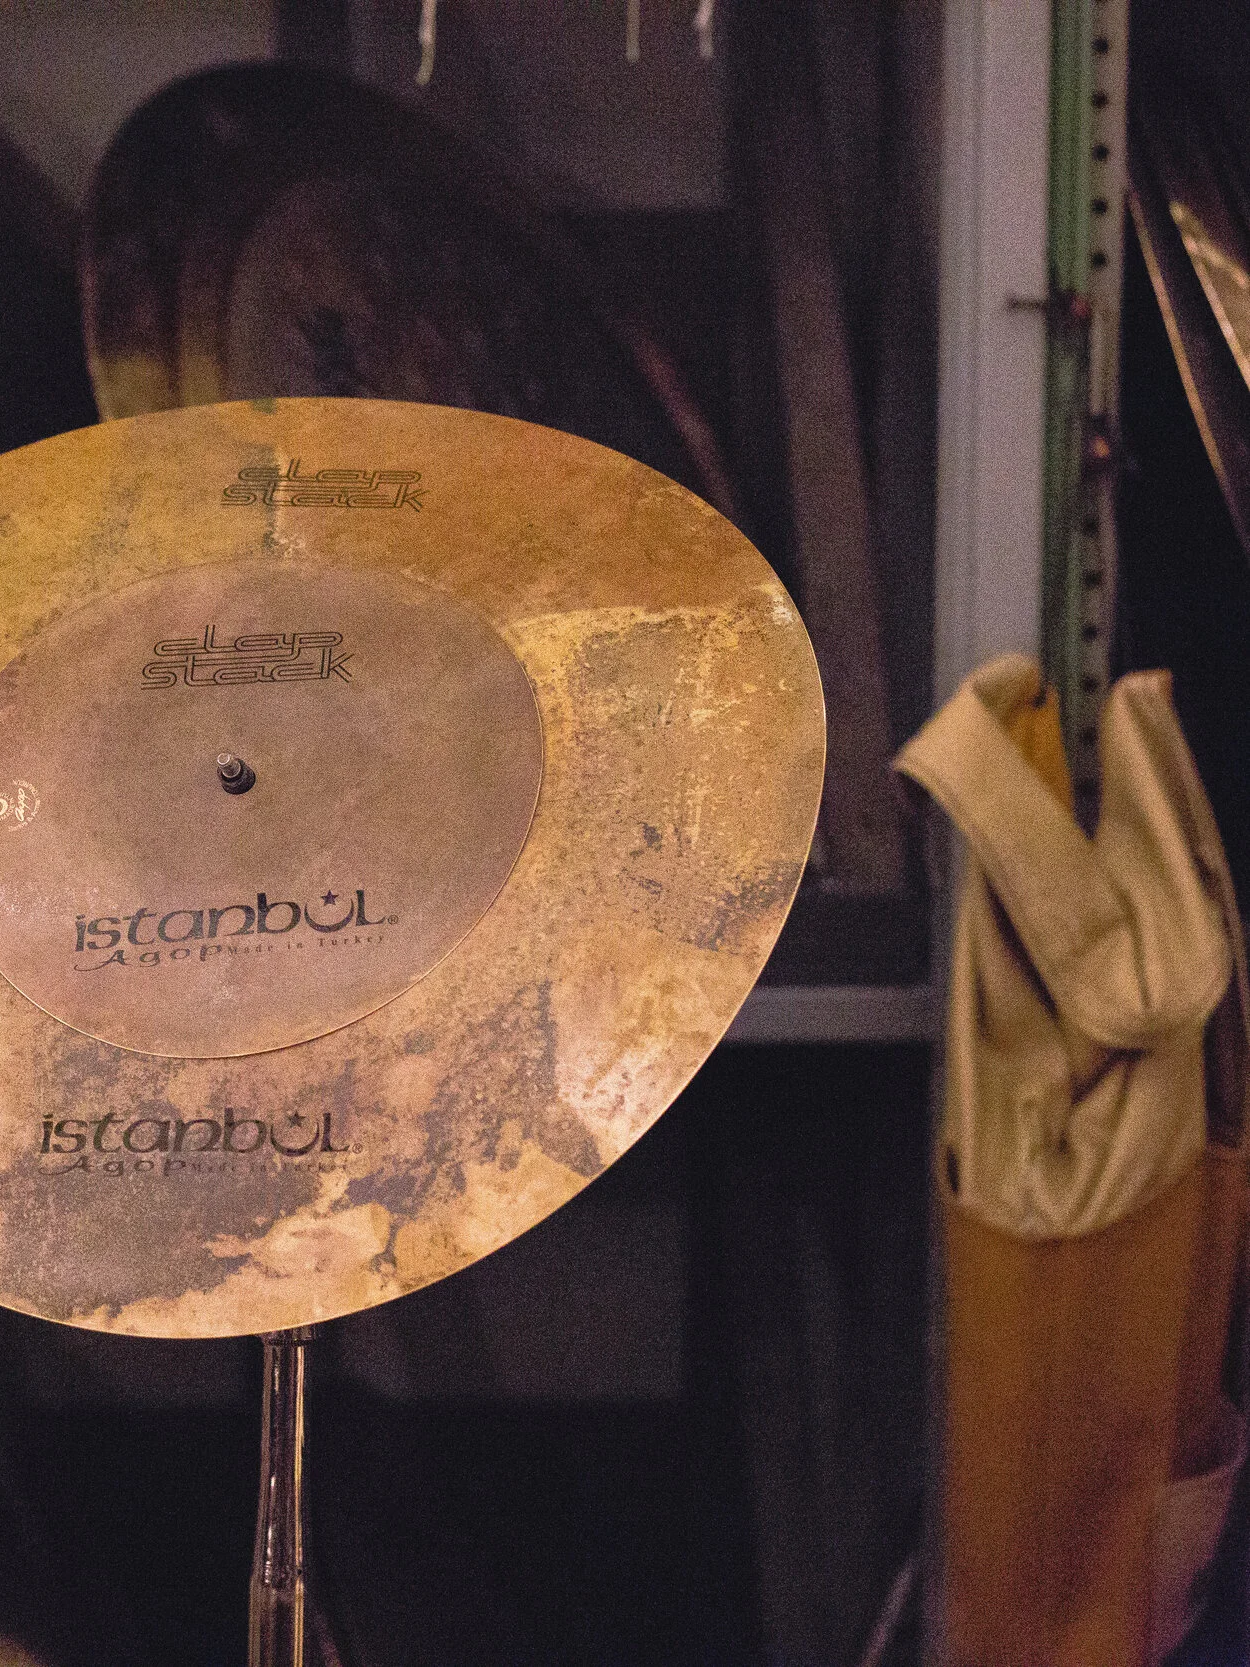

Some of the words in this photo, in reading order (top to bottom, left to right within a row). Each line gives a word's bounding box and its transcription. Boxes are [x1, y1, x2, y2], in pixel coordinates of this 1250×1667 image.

[73, 944, 223, 972] Agop
[317, 934, 386, 948] Turkey
[38, 1156, 187, 1178] Agop
